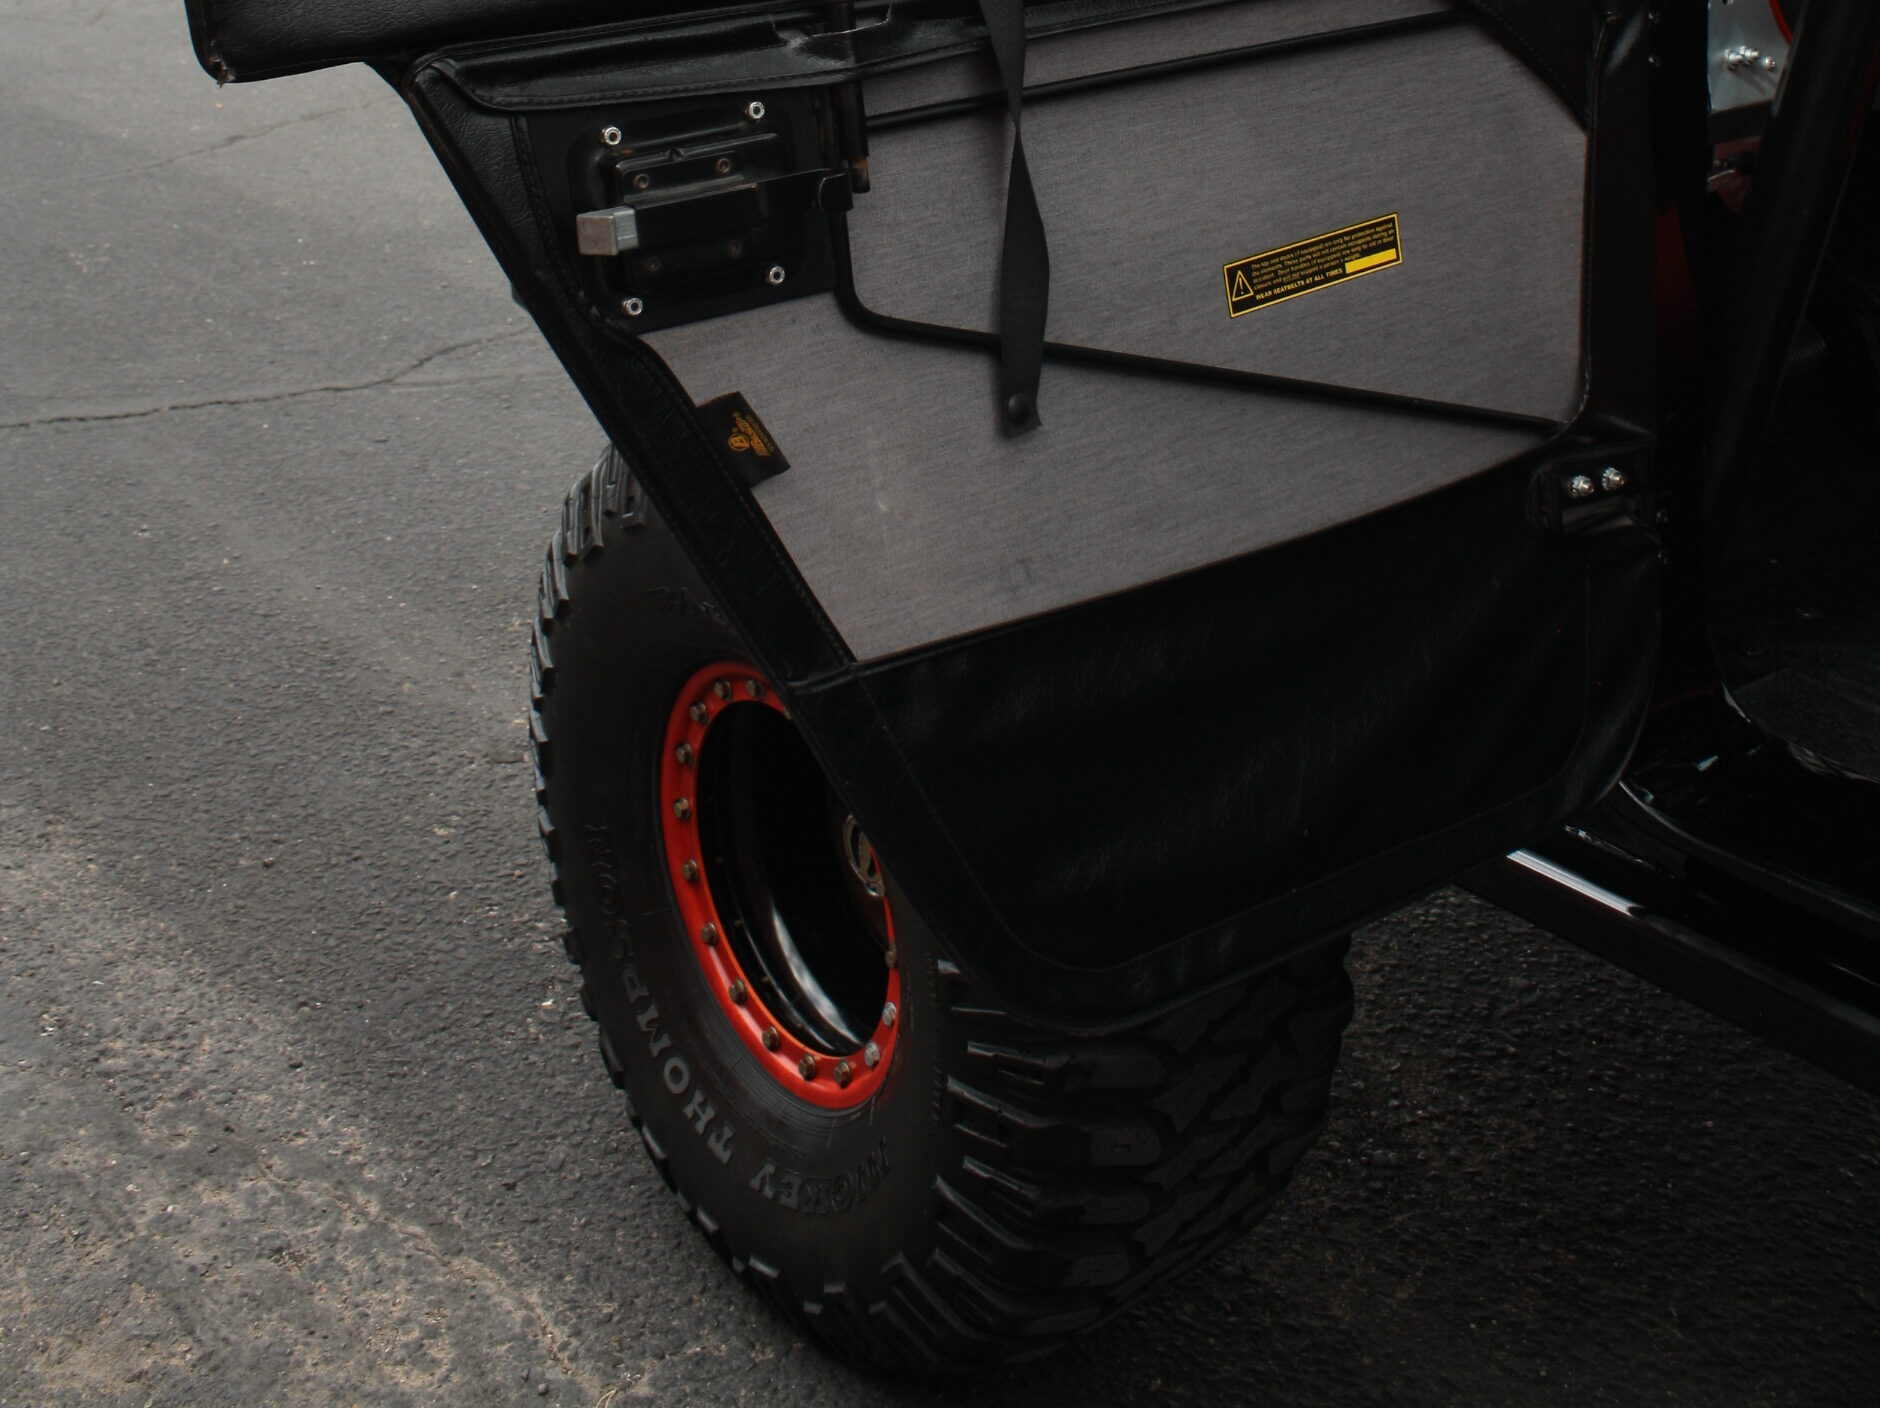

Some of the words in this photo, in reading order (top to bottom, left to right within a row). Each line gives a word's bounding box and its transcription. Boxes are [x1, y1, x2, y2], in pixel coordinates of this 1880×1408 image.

[1256, 290, 1272, 300] WEAR
[1273, 280, 1305, 295] SEATBELTS
[1314, 274, 1324, 282] ALL
[1326, 268, 1343, 278] TIMES
[584, 818, 736, 1165] THOMPSON
[748, 1137, 890, 1216] MICKEY
